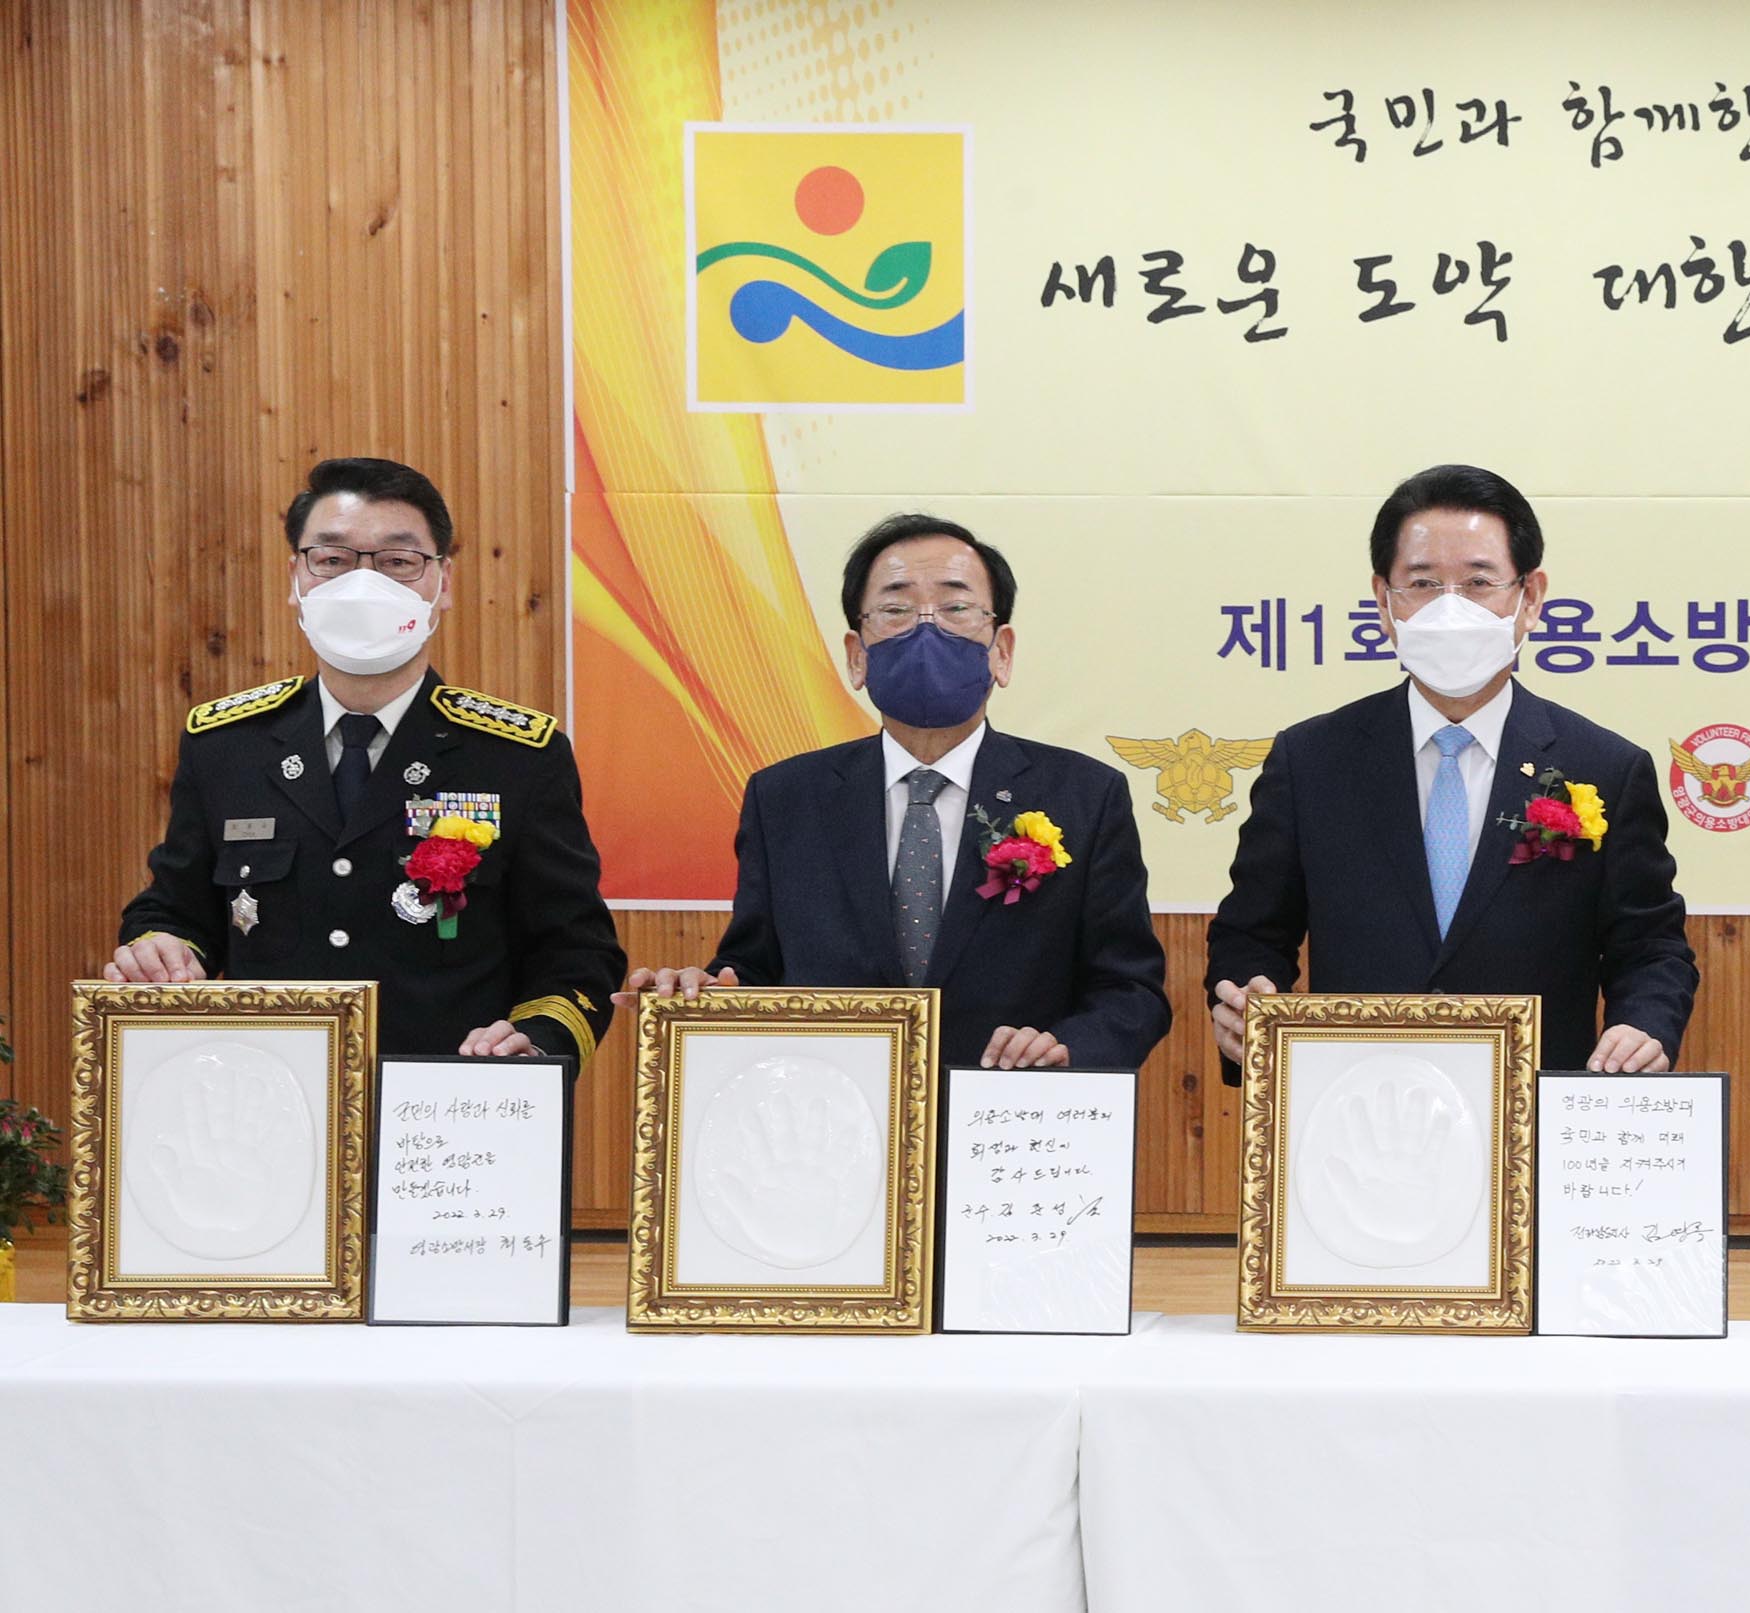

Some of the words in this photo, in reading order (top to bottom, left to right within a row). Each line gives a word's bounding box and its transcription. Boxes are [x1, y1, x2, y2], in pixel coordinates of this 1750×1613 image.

[1308, 87, 1523, 164] 국민과
[1040, 242, 1289, 344] 새로운
[1352, 240, 1513, 343] 도약
[1690, 726, 1741, 748] VOLUNTEER
[1562, 1093, 1609, 1112] 영광의
[1617, 1095, 1694, 1118] 의용소방대
[1560, 1126, 1607, 1145] 국민과
[1616, 1130, 1646, 1146] 함께
